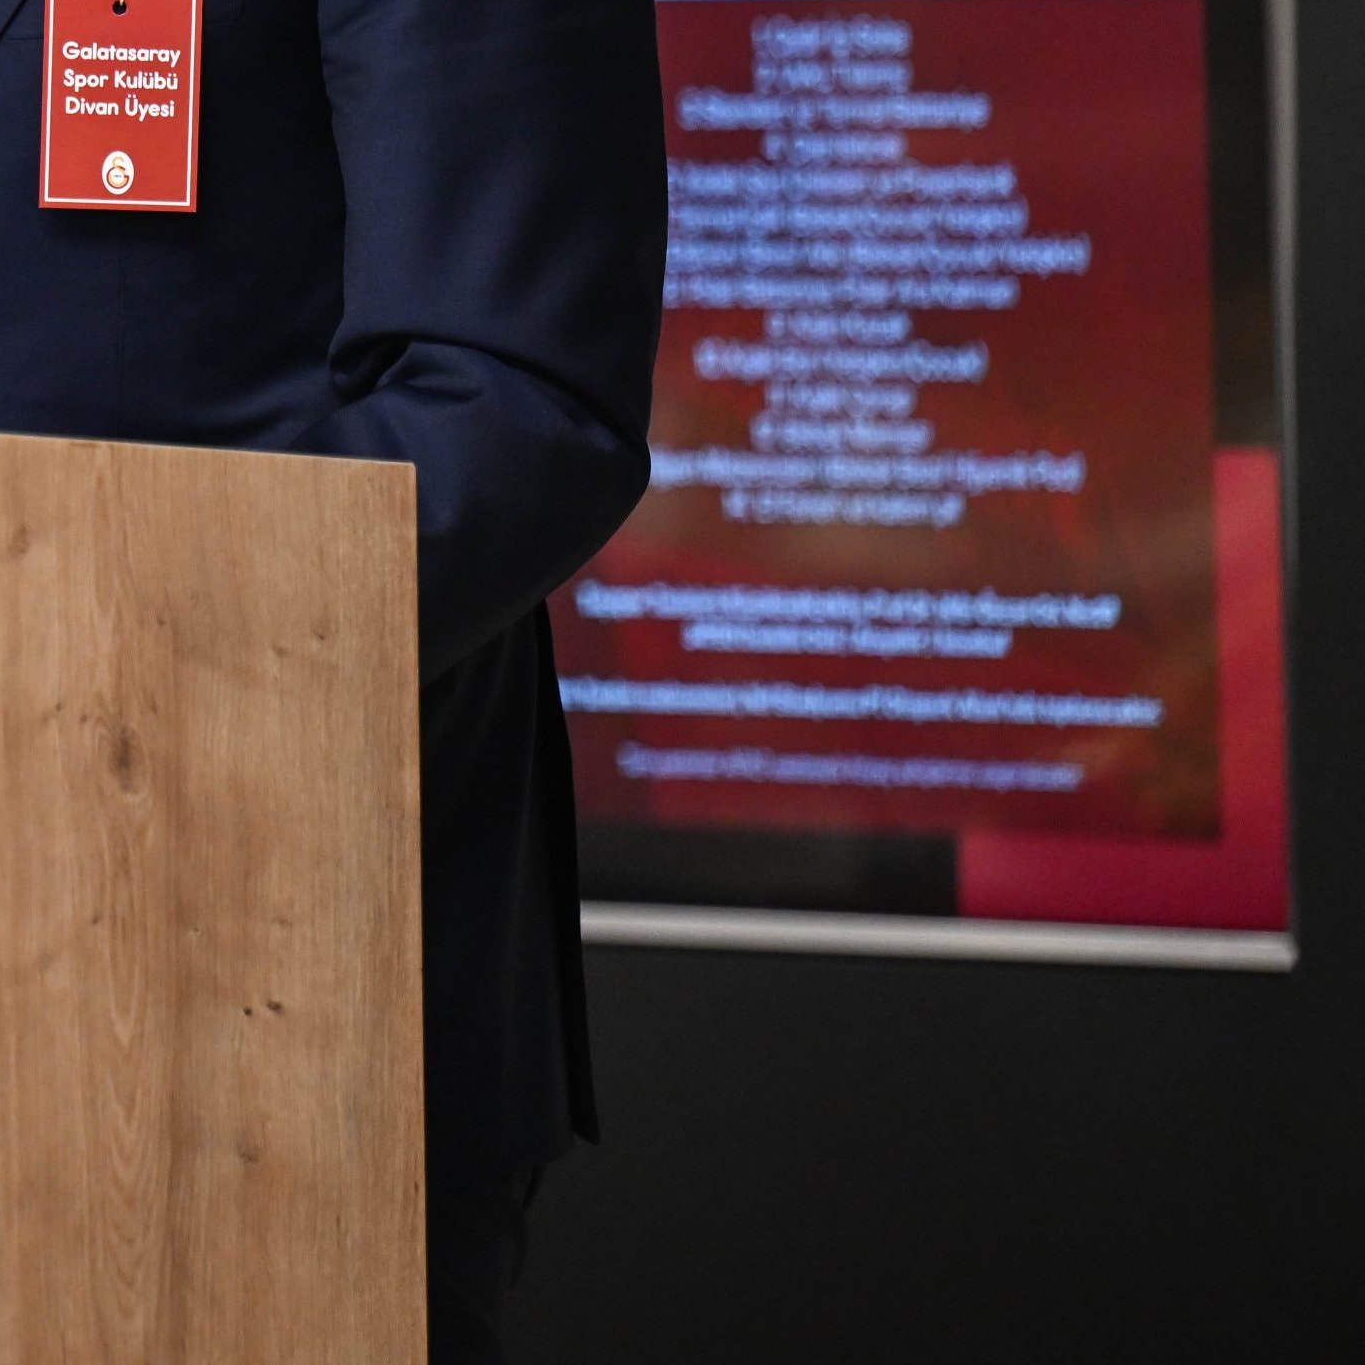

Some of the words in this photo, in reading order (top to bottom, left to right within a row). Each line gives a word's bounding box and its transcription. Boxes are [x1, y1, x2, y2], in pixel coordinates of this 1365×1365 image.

[62, 41, 181, 67] Galatasaray
[63, 69, 109, 92] Spor
[115, 71, 178, 90] Kulübü
[65, 96, 119, 115] Divan
[125, 94, 175, 121] Üyesi
